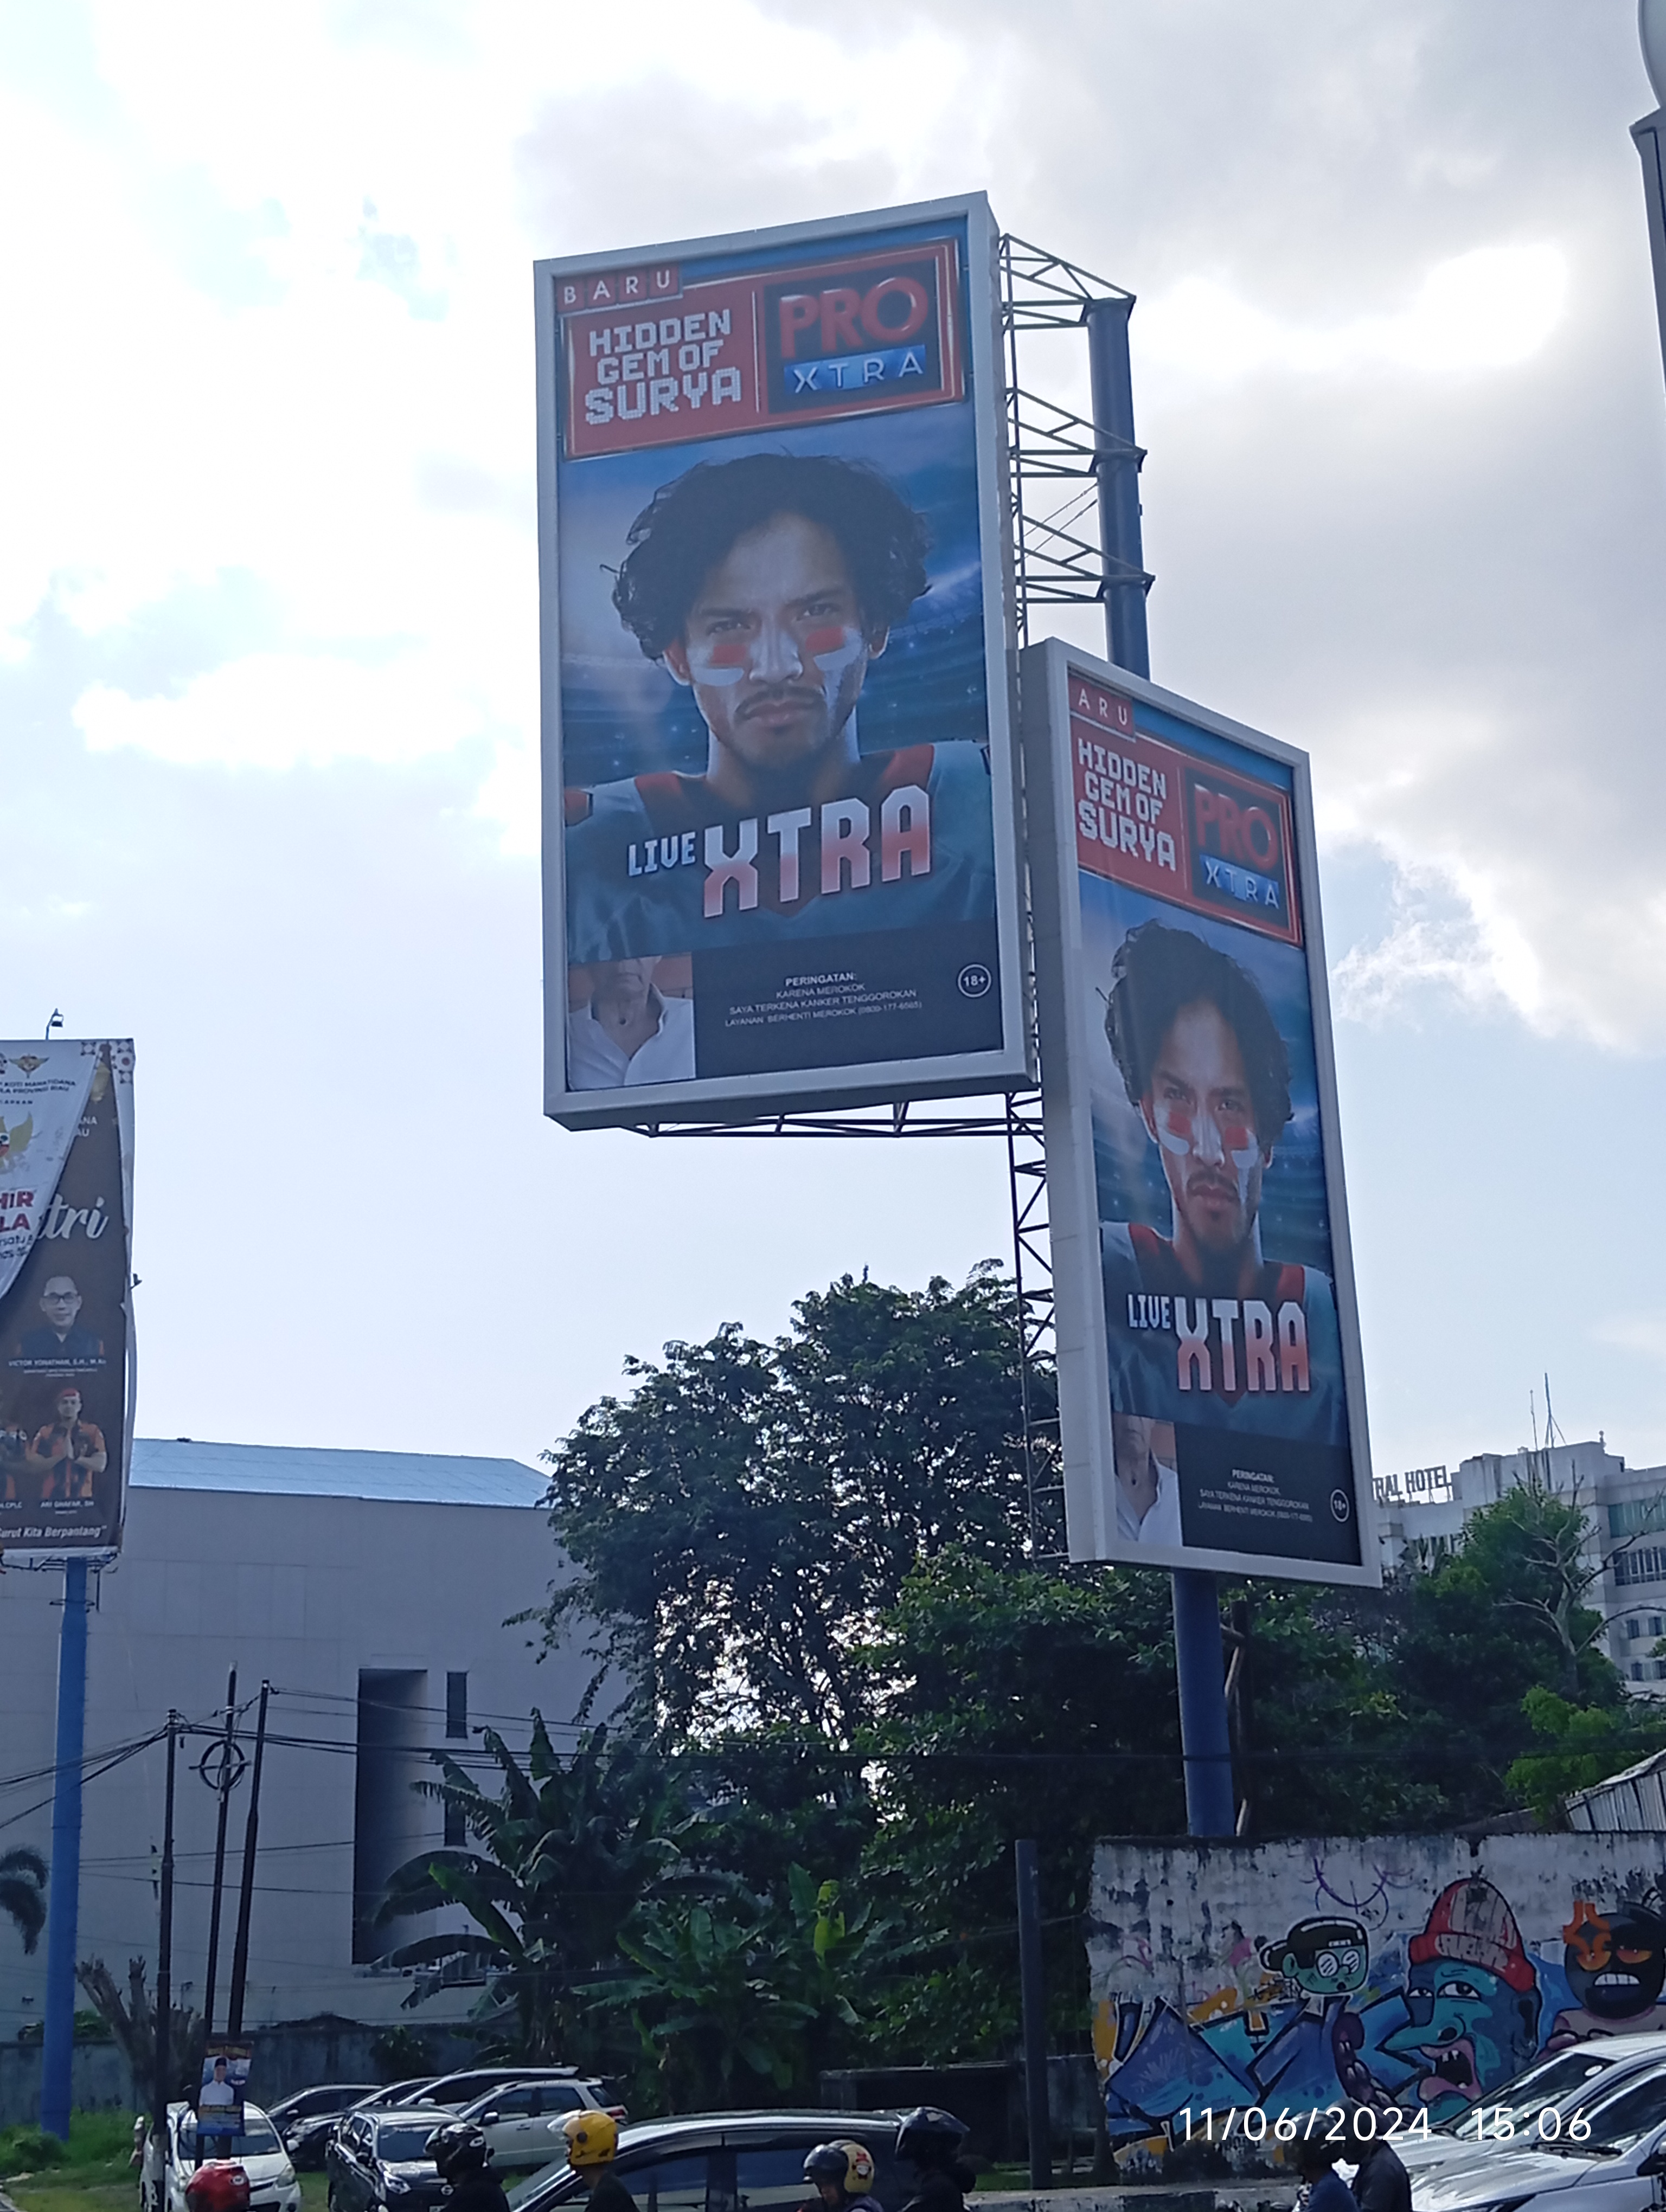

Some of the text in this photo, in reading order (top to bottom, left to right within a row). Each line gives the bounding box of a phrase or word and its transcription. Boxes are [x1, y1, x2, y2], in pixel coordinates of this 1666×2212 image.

[563, 269, 671, 305] BARU
[589, 308, 732, 357] HIDDEN
[779, 276, 929, 358] PRO
[598, 339, 724, 385] GEM OF
[793, 351, 924, 394] XTRA
[585, 366, 742, 425] SURYA
[1078, 738, 1167, 799] HIDDEN
[1085, 770, 1162, 825] GEM OF
[1078, 799, 1176, 872] SURYA
[1194, 783, 1278, 870] PRO
[628, 785, 931, 918] LIVE XTRA
[1205, 861, 1279, 909] XTRA
[729, 989, 917, 1015] SAYA TERKENA KANKER TENGGOROKAN
[776, 983, 866, 999] KARENA MEROKOK
[963, 975, 986, 987] 18+
[725, 1017, 764, 1027] LAYANAN
[813, 1007, 856, 1018] MEROKOK
[1128, 1294, 1310, 1392] LIVE XTRA
[1405, 1465, 1452, 1493] HOTEL
